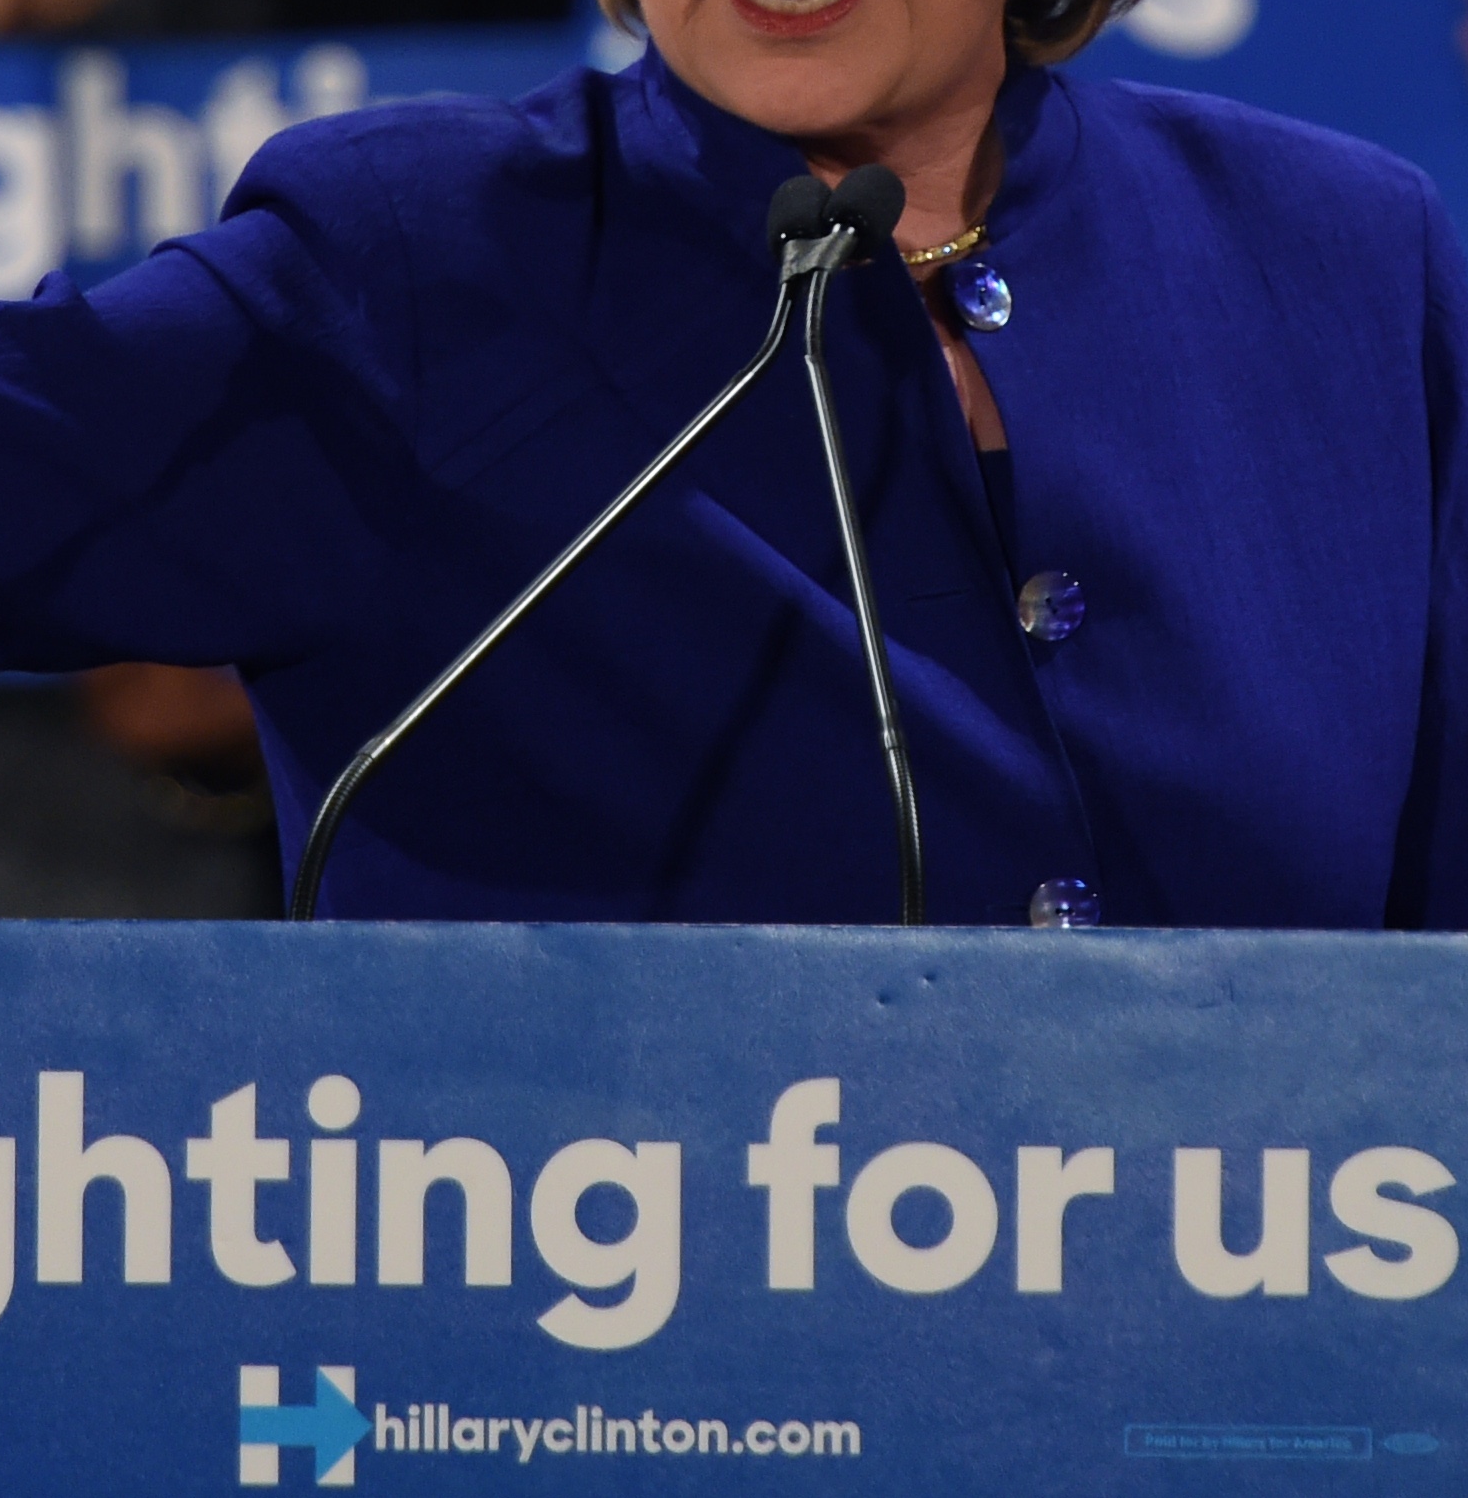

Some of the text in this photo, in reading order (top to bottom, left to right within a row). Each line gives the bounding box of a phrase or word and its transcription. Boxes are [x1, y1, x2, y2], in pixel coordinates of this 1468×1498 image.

[746, 1076, 1115, 1295] for
[1172, 1145, 1461, 1302] us
[374, 1402, 862, 1464] hillaryclinton.com
